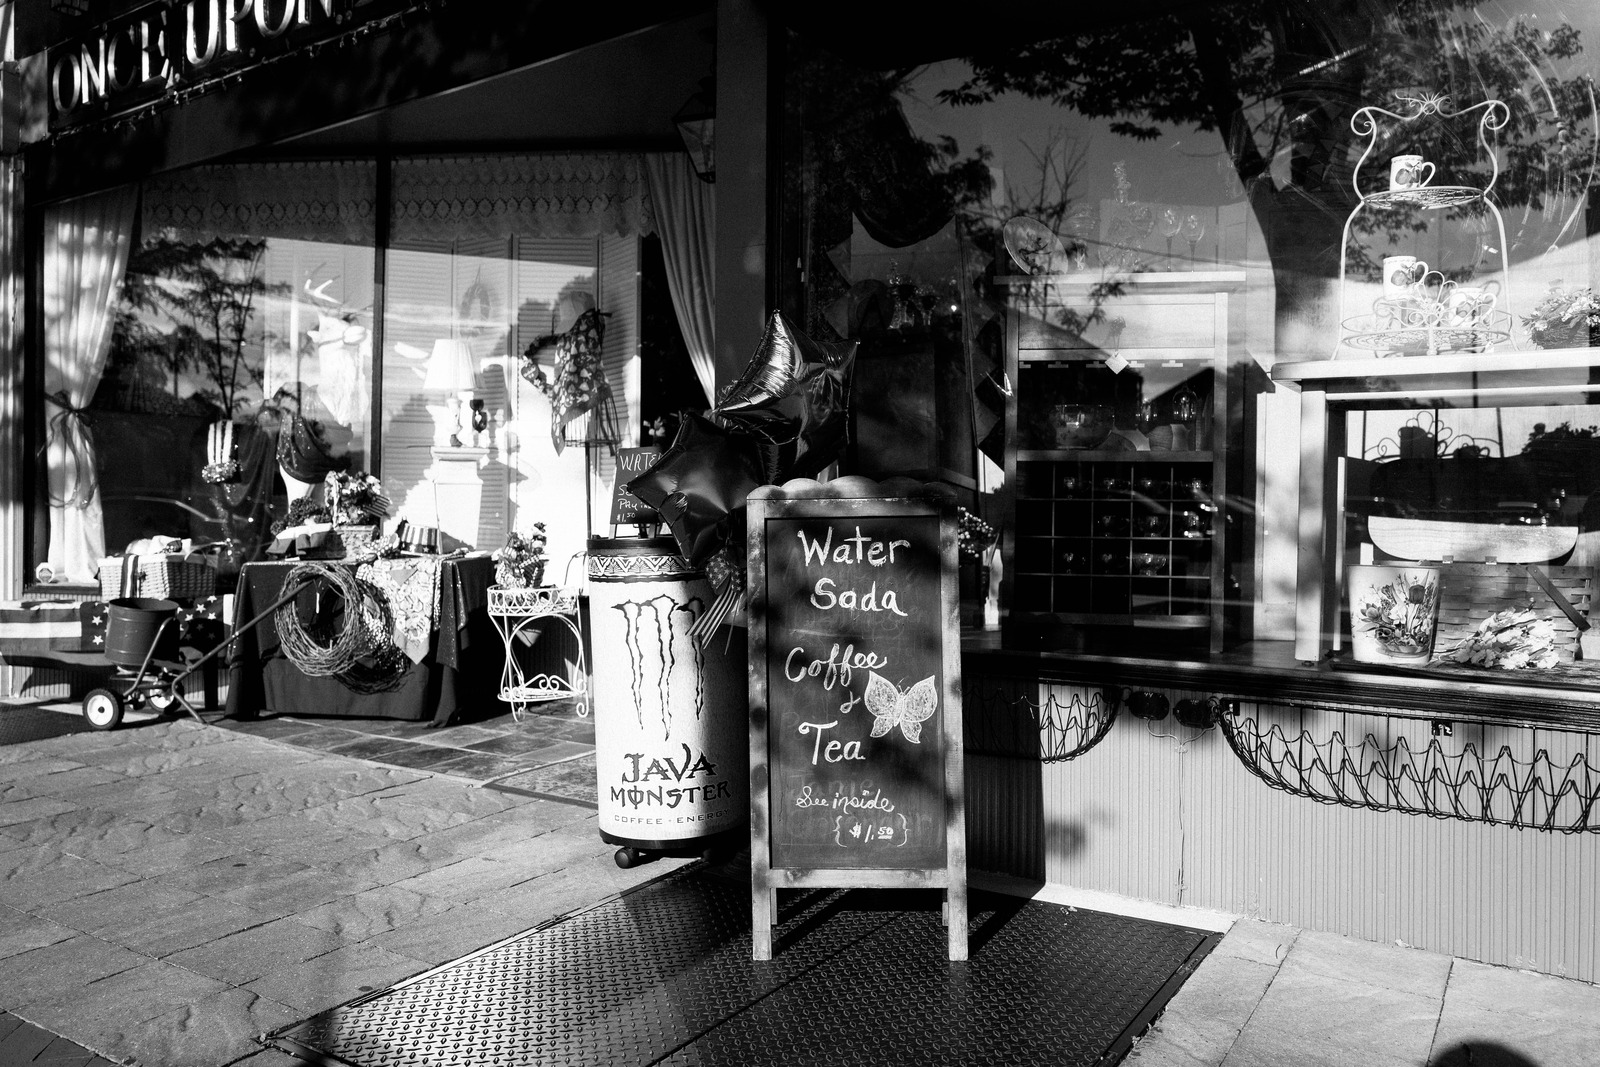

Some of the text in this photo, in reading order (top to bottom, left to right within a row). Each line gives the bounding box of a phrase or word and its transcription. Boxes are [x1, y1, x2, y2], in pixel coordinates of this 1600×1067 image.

[52, 10, 173, 114] ONCE
[797, 526, 911, 567] Water
[784, 643, 888, 691] Coffee
[621, 743, 718, 784] JAVA
[798, 720, 866, 766] Tea
[610, 780, 732, 810] MONSTER
[795, 785, 829, 809] See
[832, 788, 895, 815] inside
[614, 809, 729, 825] COFFEE ENERGY
